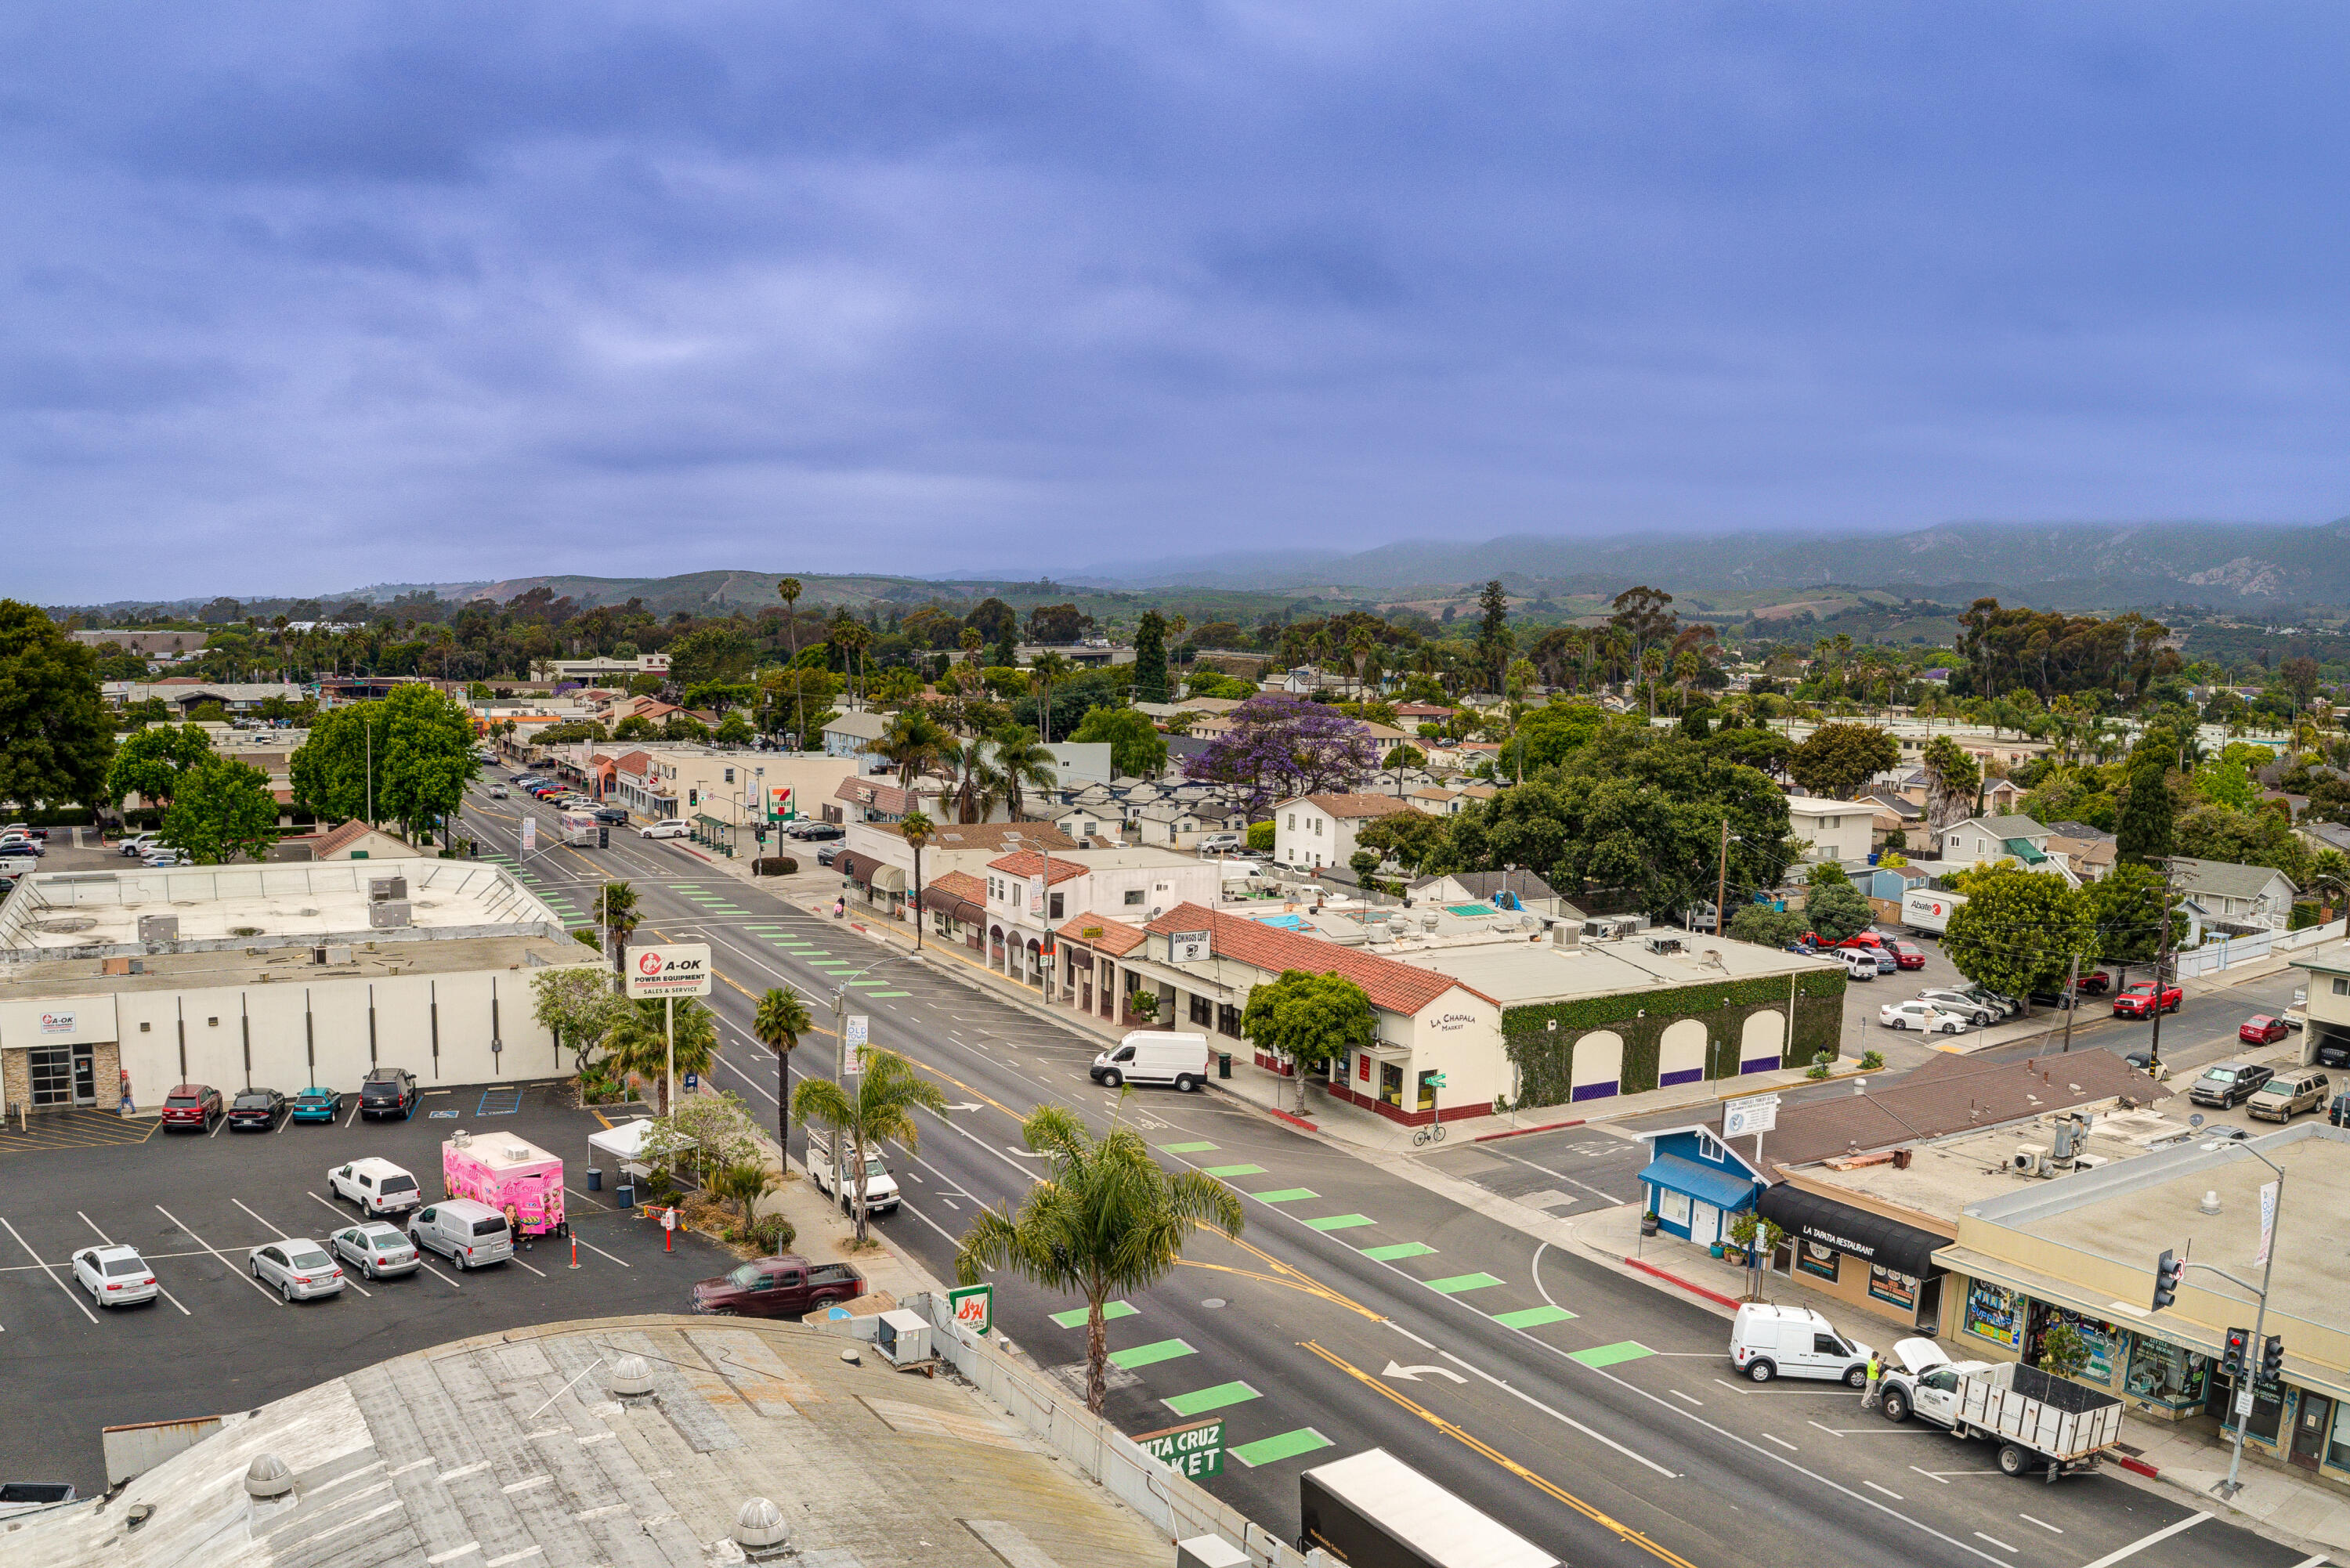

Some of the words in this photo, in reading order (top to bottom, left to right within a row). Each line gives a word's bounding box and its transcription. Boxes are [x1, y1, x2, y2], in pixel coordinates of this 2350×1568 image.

[772, 788, 790, 815] 7
[1175, 934, 1197, 944] DOMINGOS
[664, 960, 702, 970] A-OK
[1430, 1020, 1441, 1028] LA
[1443, 1013, 1476, 1024] CHAPALA
[502, 1180, 514, 1196] La
[1803, 1225, 1813, 1235] LA
[1813, 1229, 1836, 1244] TAPATIA
[1835, 1237, 1875, 1256] RESTAURANT
[1971, 1304, 2012, 1325] SUPPLIES
[2142, 1340, 2155, 1349] DOG
[2156, 1346, 2175, 1356] HOUSE
[2149, 1338, 2168, 1347] LITTLE
[1140, 1436, 1174, 1457] NTA
[1177, 1425, 1220, 1451] CRUZ
[1171, 1447, 1220, 1477] KET
